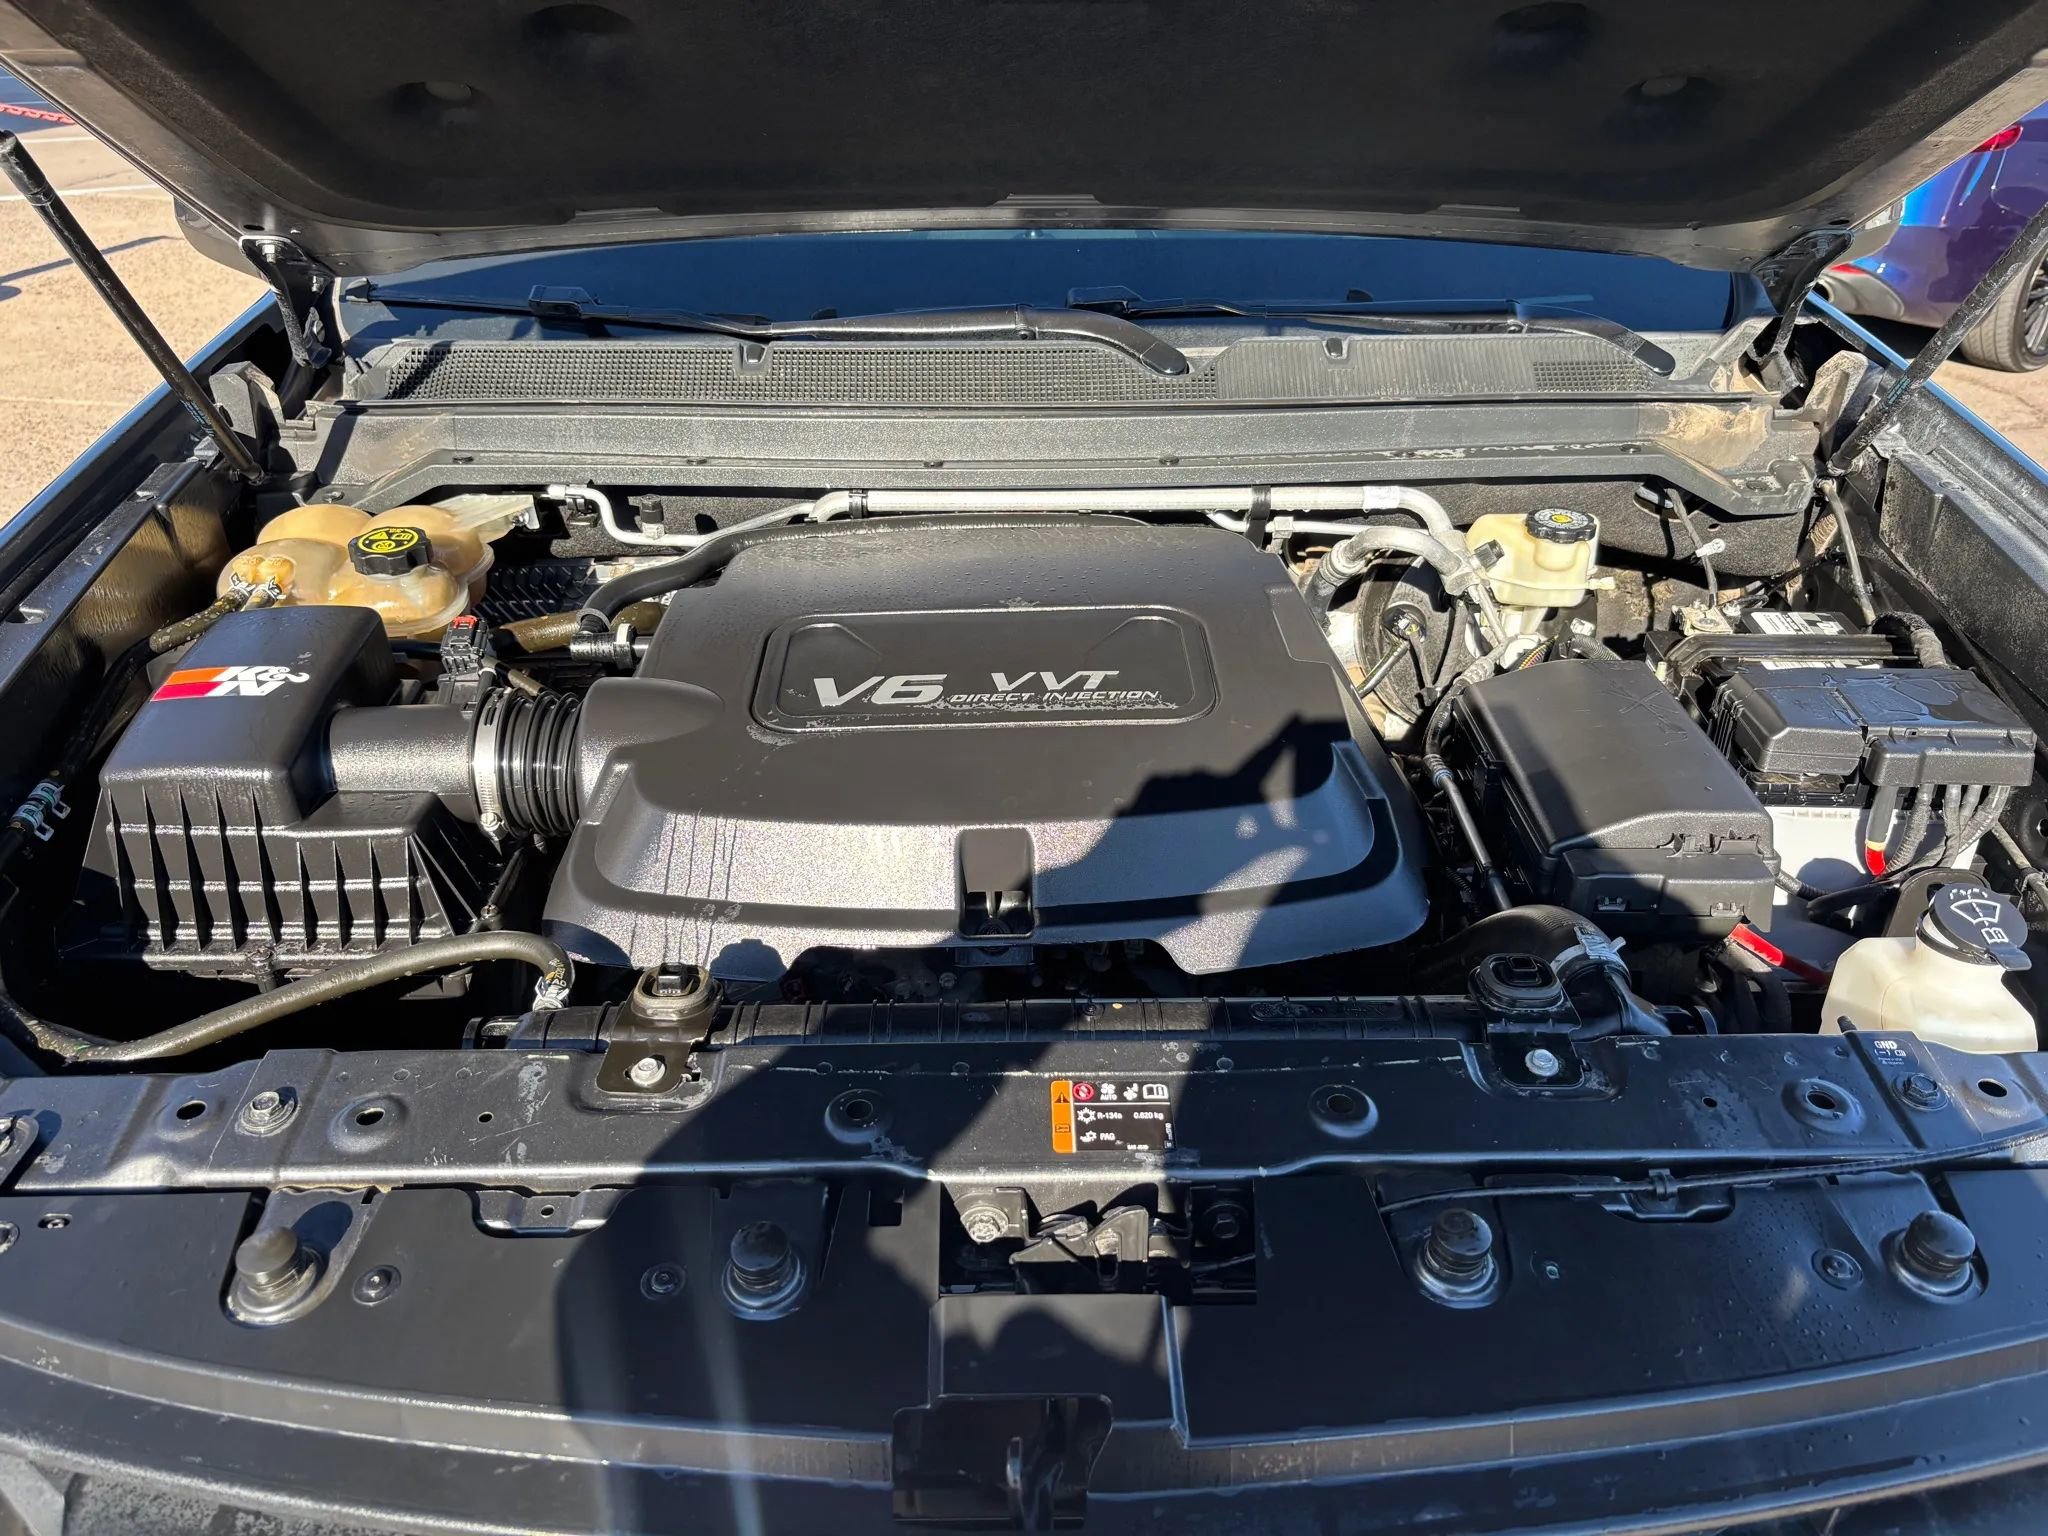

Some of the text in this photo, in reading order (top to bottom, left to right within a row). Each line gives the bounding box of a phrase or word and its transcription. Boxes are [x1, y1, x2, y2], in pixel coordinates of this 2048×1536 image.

[204, 665, 310, 697] K&N
[991, 670, 1120, 692] VVT
[813, 674, 948, 707] V6
[950, 690, 1159, 703] DIRECT INJECTION
[1874, 1040, 1898, 1050] GND
[1154, 1111, 1164, 1121] kg
[1099, 1132, 1116, 1141] PAG
